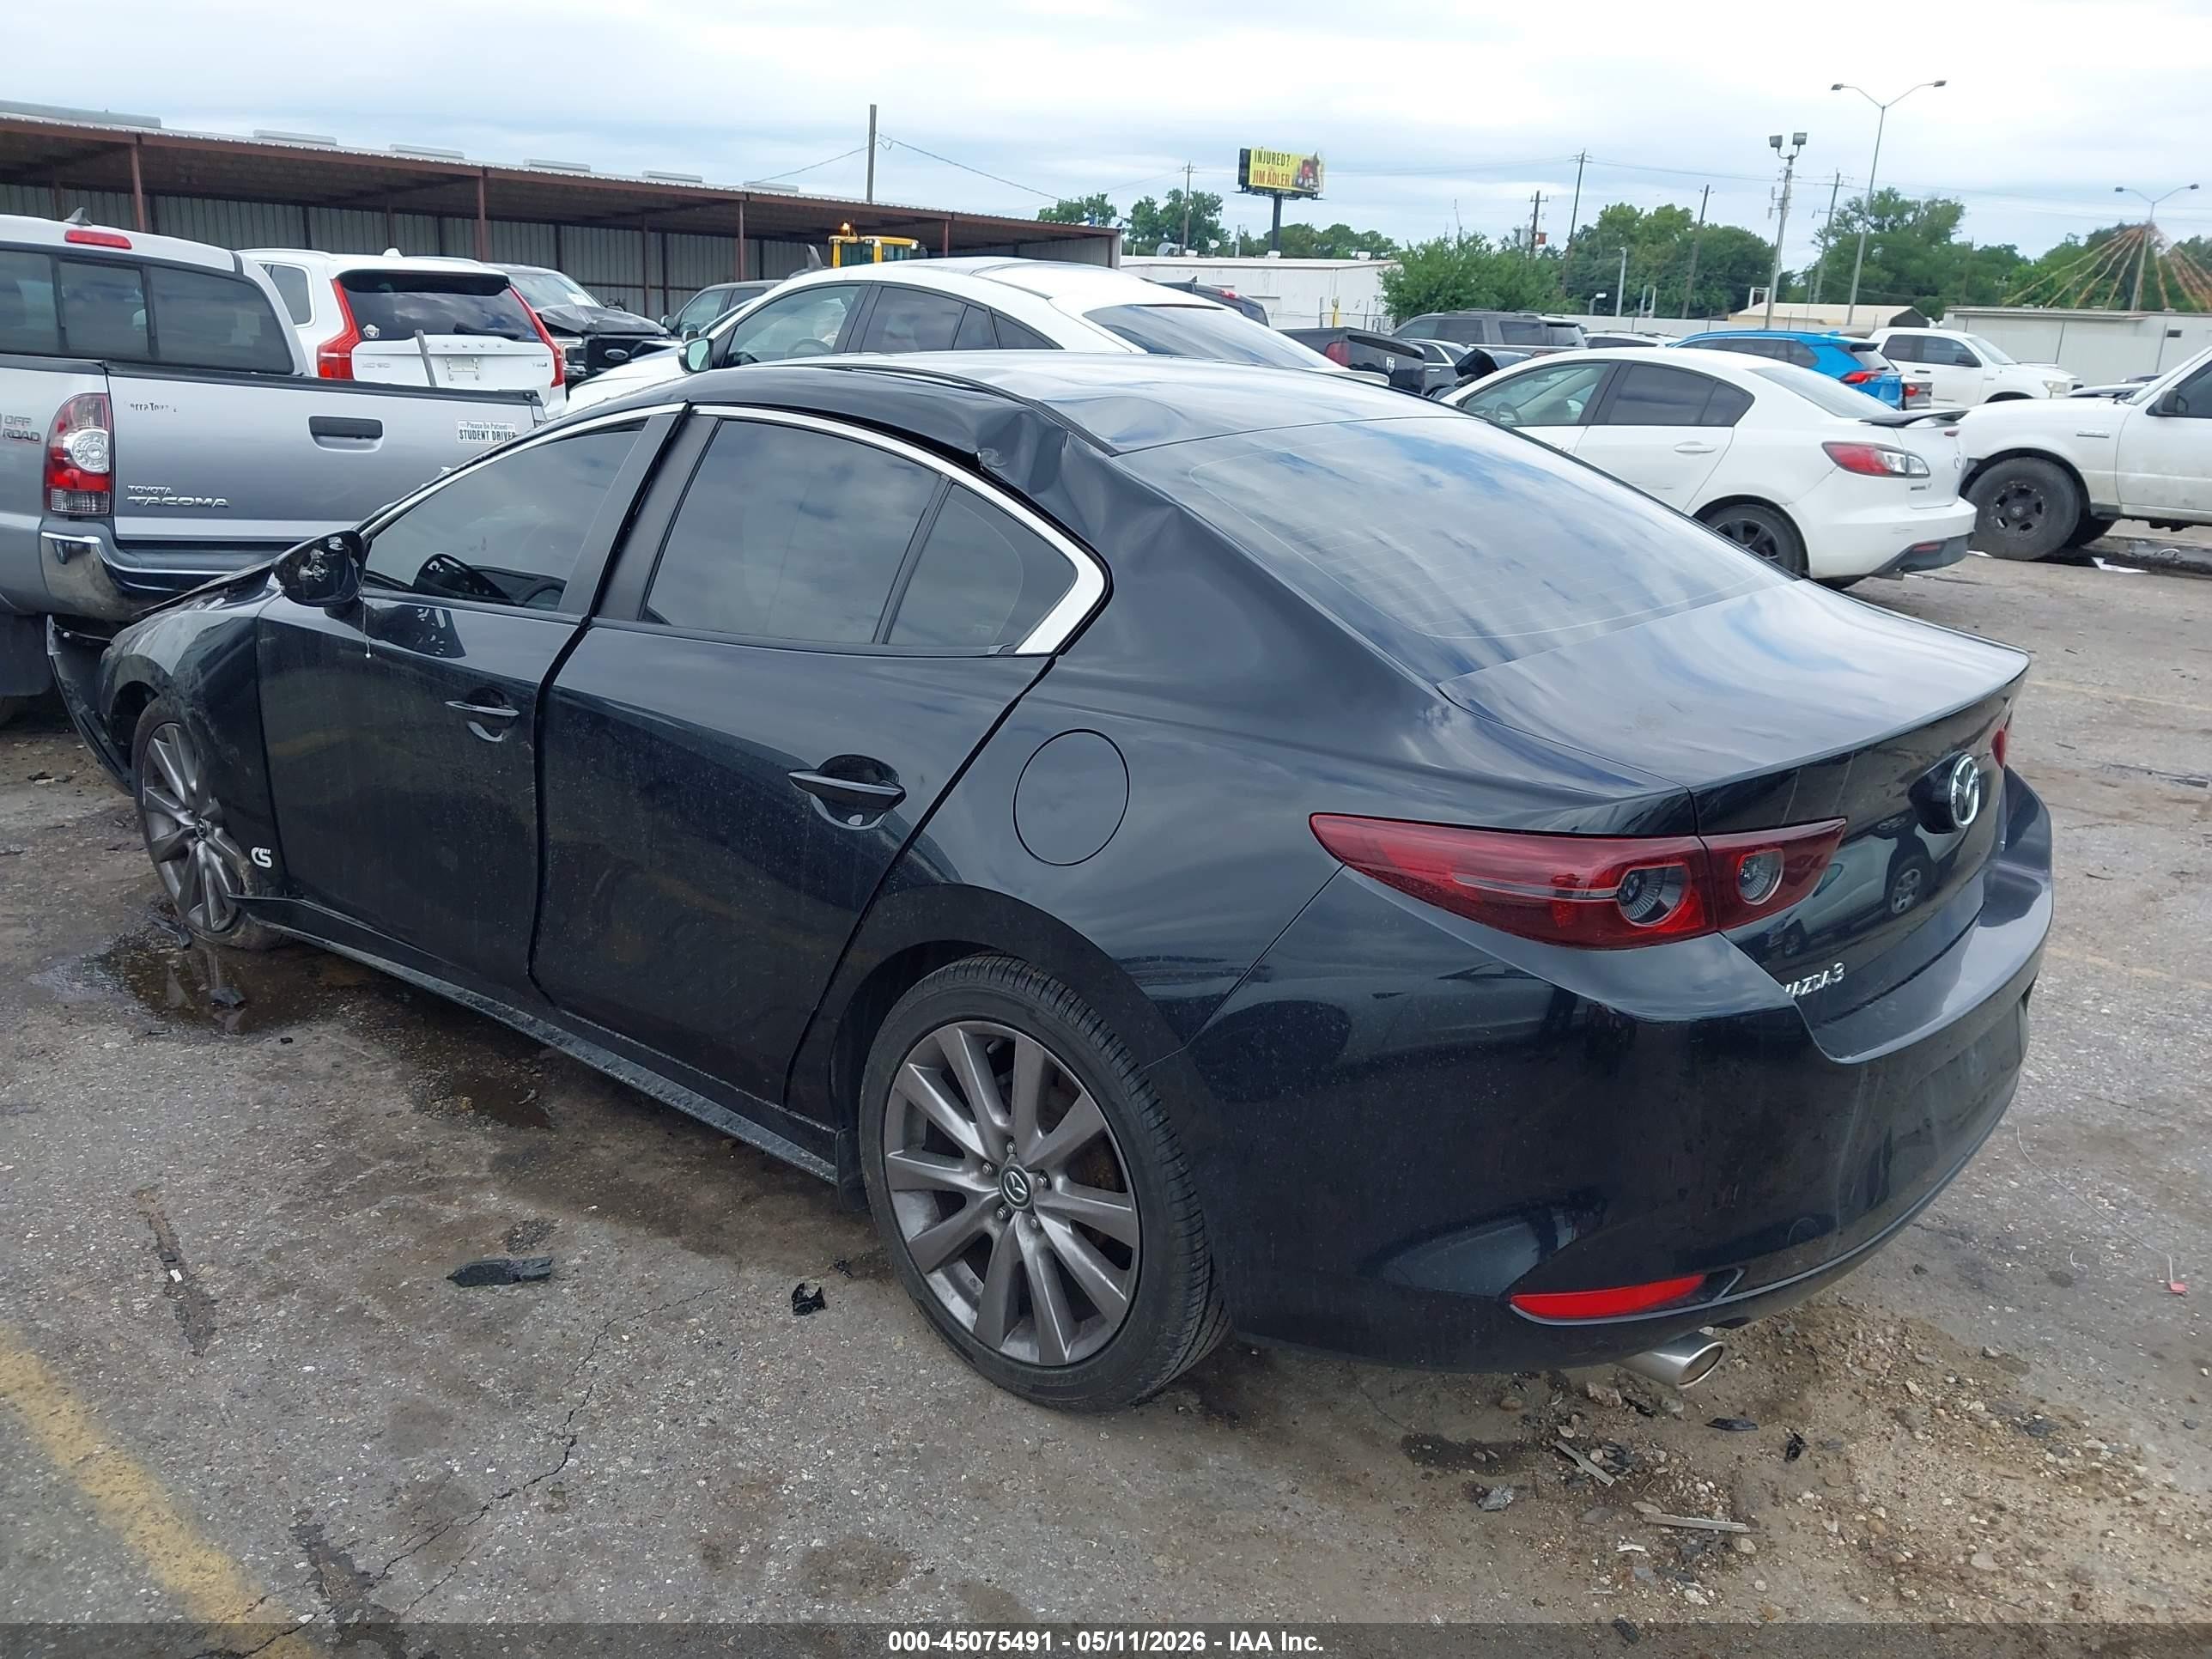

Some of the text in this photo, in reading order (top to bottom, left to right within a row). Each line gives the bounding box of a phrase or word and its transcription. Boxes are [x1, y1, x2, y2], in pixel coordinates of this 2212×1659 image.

[1255, 149, 1291, 167] INJURED?
[1252, 170, 1291, 187] JIM ADLER
[4, 415, 32, 426] OFF
[3, 428, 41, 442] ROAD
[459, 429, 489, 441] STUDENT
[127, 484, 173, 495] TOYOTA
[126, 495, 230, 508] TACOMA
